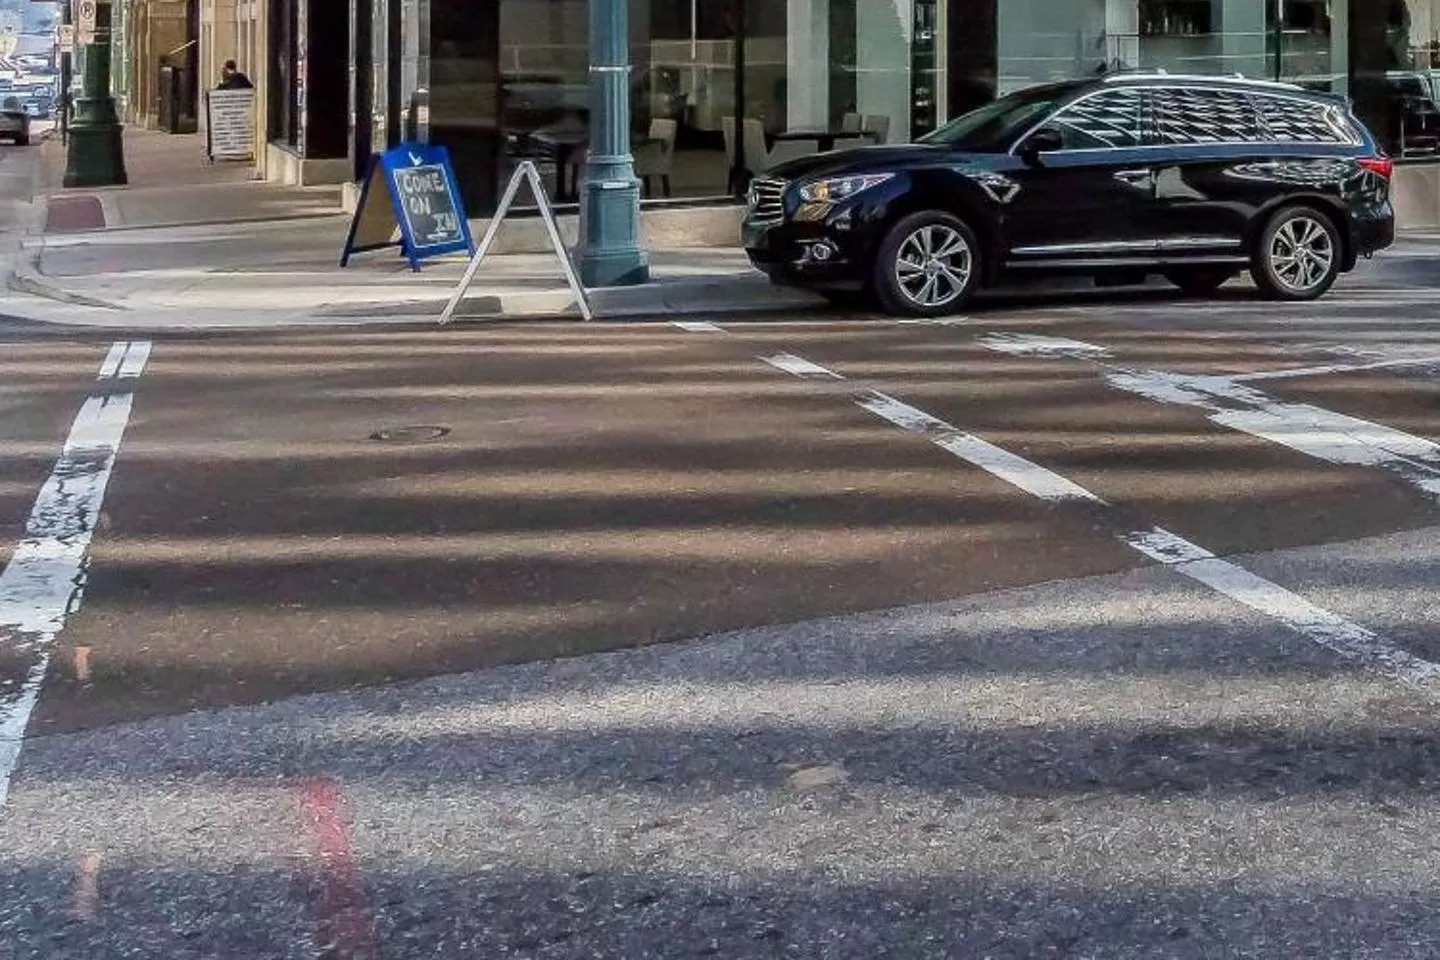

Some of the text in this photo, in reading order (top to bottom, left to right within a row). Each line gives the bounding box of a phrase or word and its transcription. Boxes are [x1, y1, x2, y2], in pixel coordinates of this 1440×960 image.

[402, 172, 444, 193] COME
[409, 196, 432, 215] ON
[432, 212, 458, 233] IN
